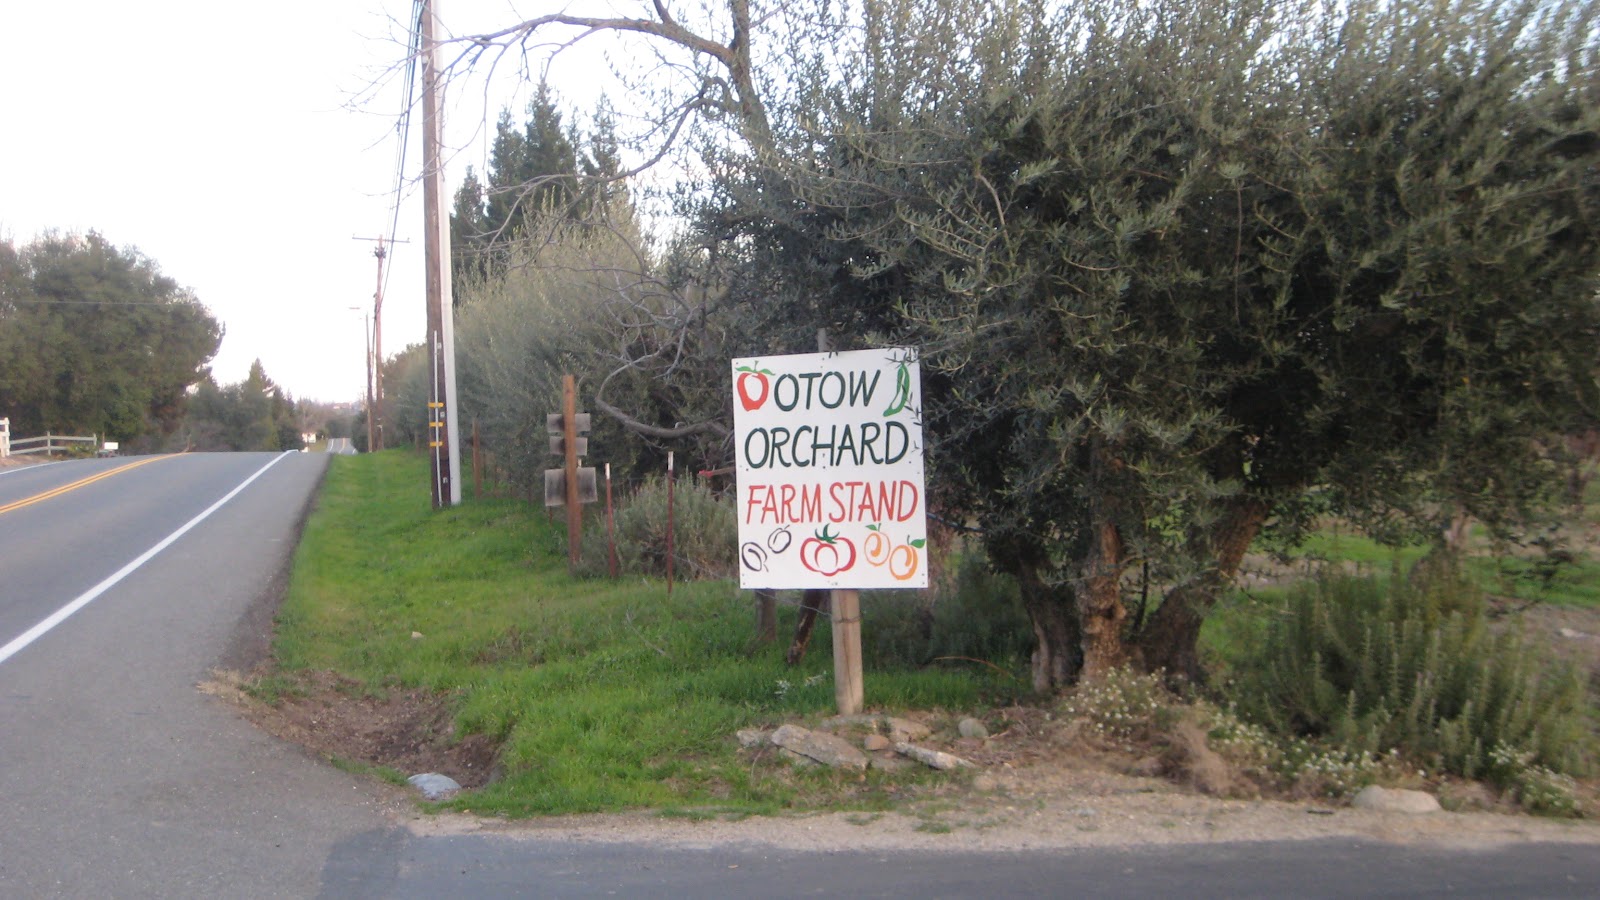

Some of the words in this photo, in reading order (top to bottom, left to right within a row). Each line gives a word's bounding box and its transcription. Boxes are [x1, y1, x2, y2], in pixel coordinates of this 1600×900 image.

[774, 369, 881, 412] OTOW
[744, 421, 909, 469] ORCHARD
[746, 484, 822, 525] FARM
[829, 480, 918, 523] STAND
